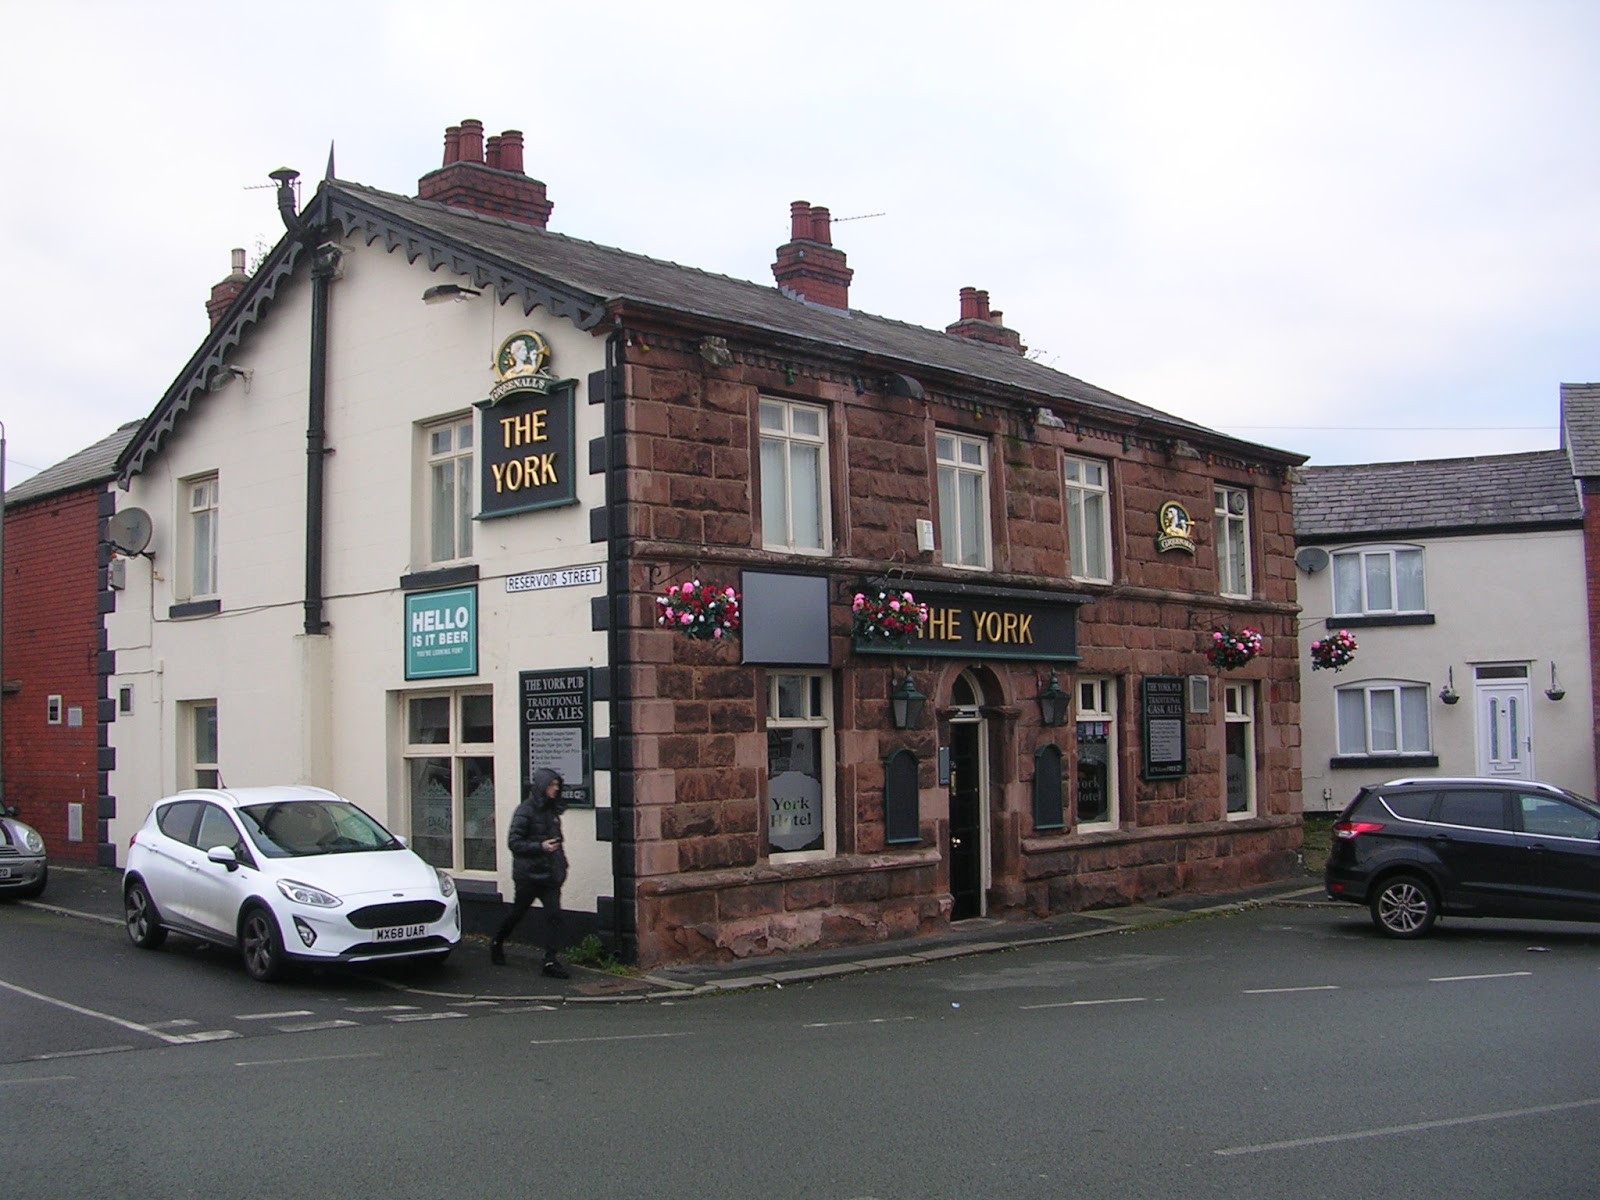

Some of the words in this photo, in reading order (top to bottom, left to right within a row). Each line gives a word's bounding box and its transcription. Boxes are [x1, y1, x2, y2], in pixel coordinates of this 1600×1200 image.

[500, 409, 548, 448] THE
[491, 452, 558, 494] YORK
[508, 572, 557, 590] RESERVOIR
[562, 568, 598, 585] STREET
[412, 606, 469, 633] HELLO
[973, 610, 1034, 645] YORK
[412, 635, 422, 648] IS
[425, 634, 436, 646] IT
[439, 631, 469, 645] BEER
[525, 679, 542, 691] THE
[543, 678, 566, 690] YORK
[567, 676, 584, 689] PUB
[1157, 682, 1171, 692] YORK
[1172, 682, 1182, 692] PUB
[527, 696, 583, 708] TRADITIONAL
[1147, 705, 1165, 714] CASK
[1167, 704, 1182, 714] ALES
[526, 708, 554, 721] CASK
[557, 706, 583, 720] ALES
[772, 797, 809, 811] York
[377, 928, 404, 940] MX68
[406, 925, 425, 937] UAR
